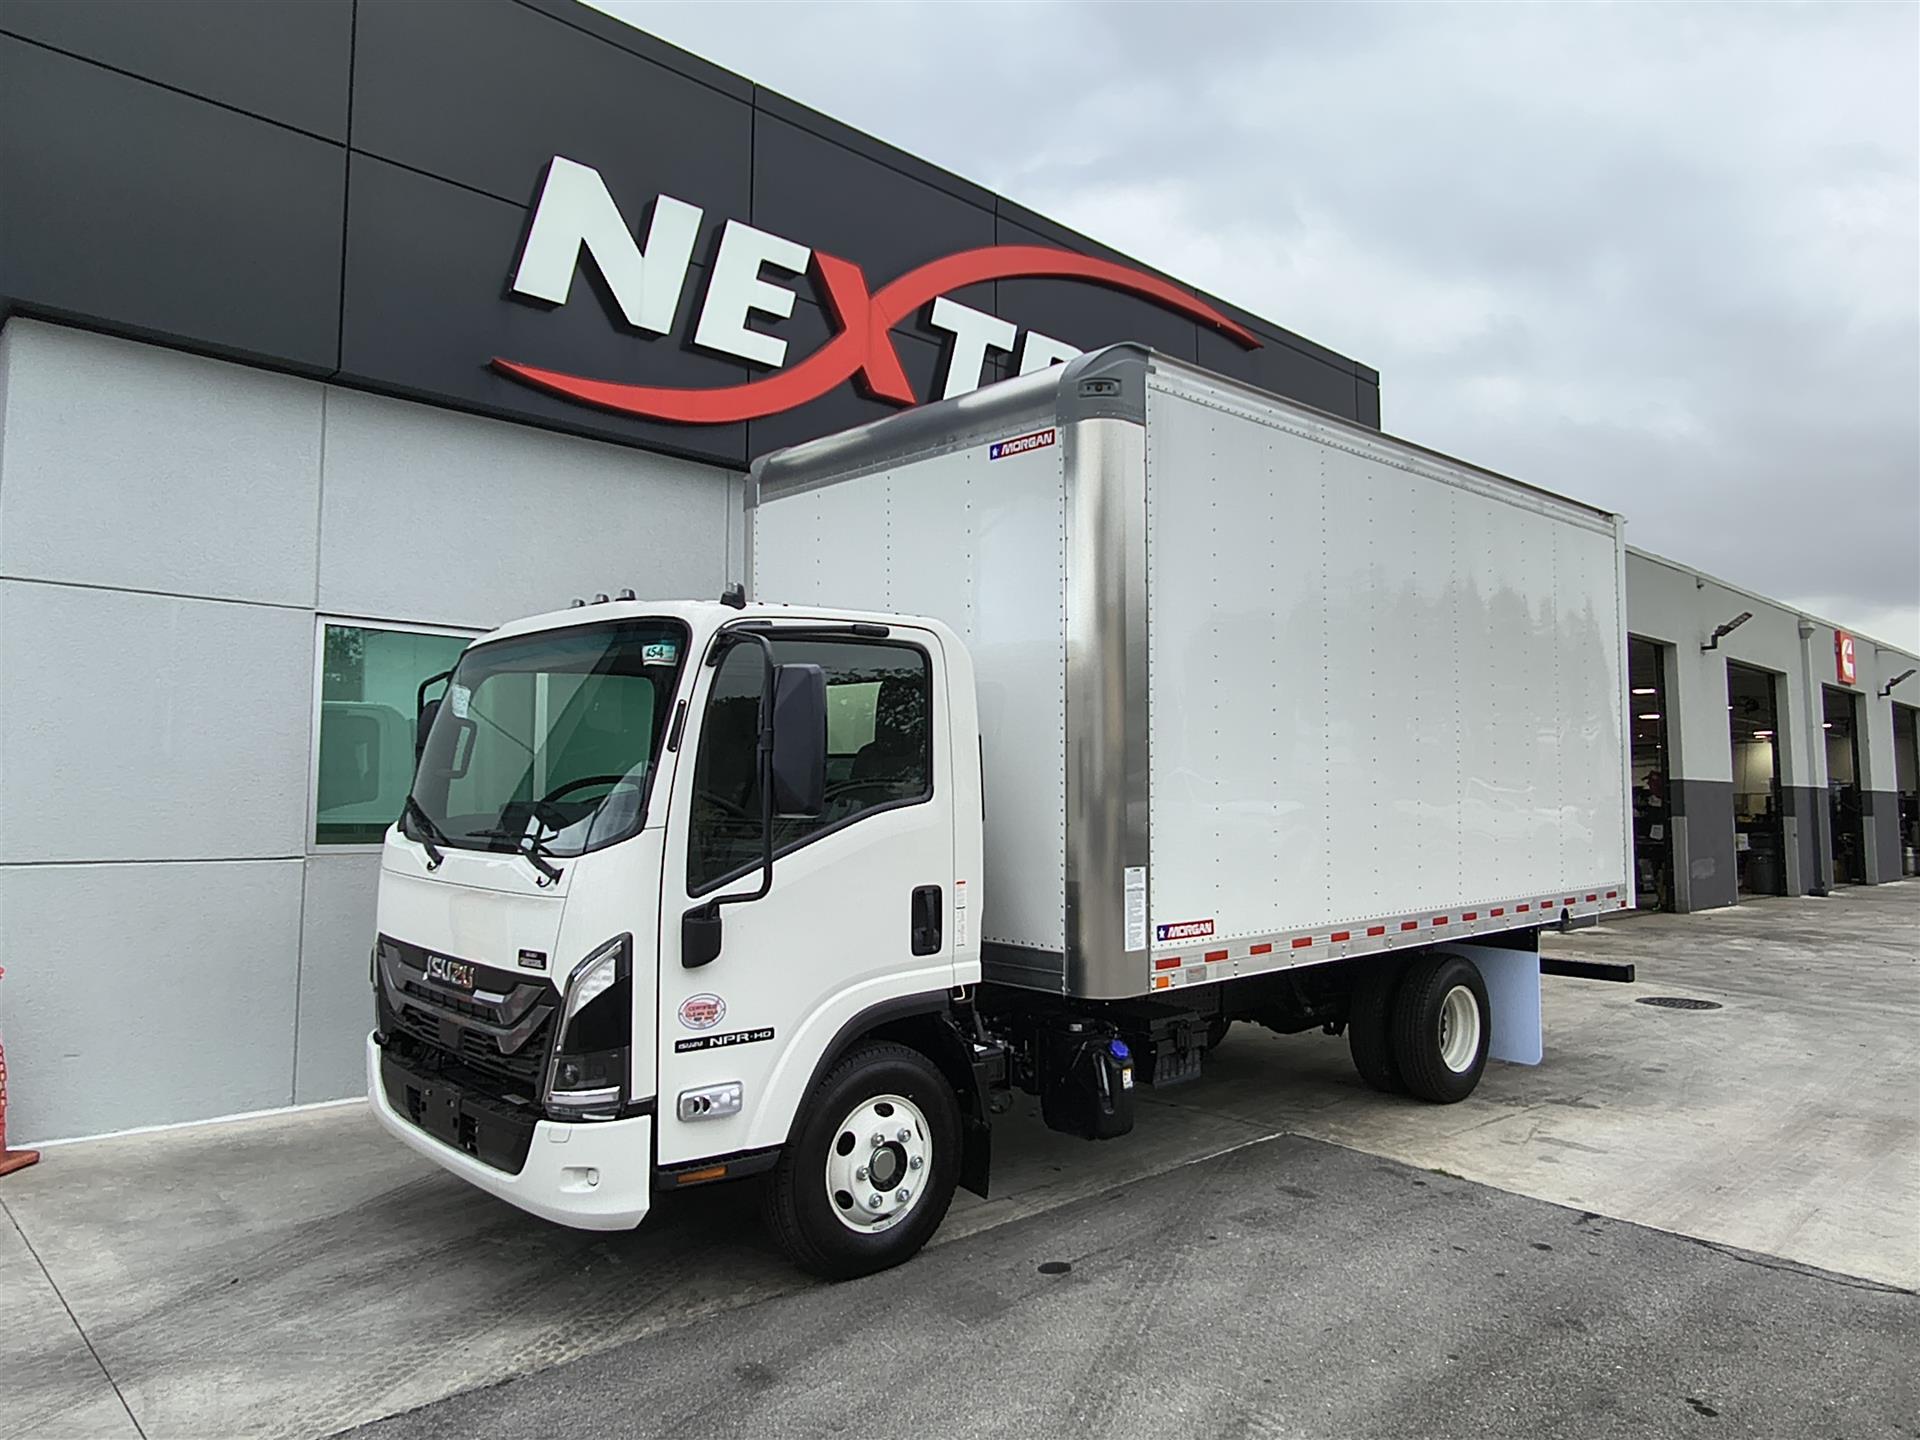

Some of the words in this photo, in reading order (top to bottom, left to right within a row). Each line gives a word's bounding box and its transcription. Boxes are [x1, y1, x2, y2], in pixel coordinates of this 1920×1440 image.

[1001, 432, 1053, 456] MORGAN
[1167, 921, 1213, 938] MORGAN
[424, 955, 476, 989] ISUZU
